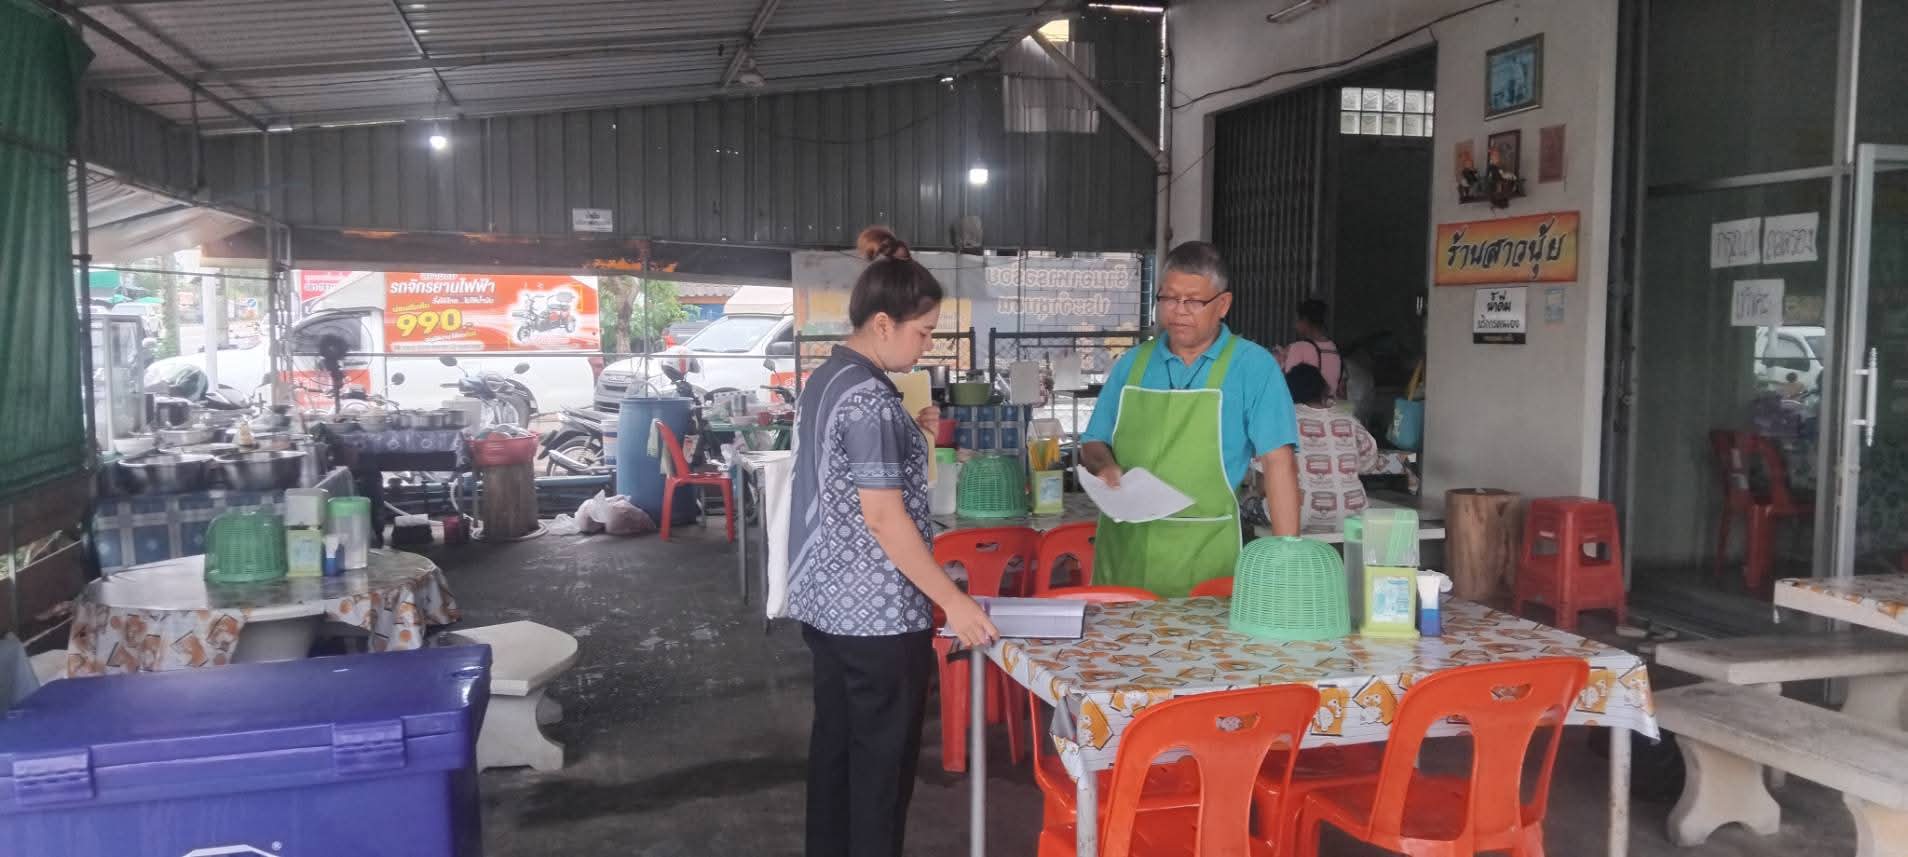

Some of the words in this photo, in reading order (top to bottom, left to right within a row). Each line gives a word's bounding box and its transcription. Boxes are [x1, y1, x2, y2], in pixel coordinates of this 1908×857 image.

[1448, 216, 1566, 278] ร้านสาวนุ้ย
[389, 276, 496, 295] รถจักรยานไฟฟ้า
[397, 309, 462, 336] 990
